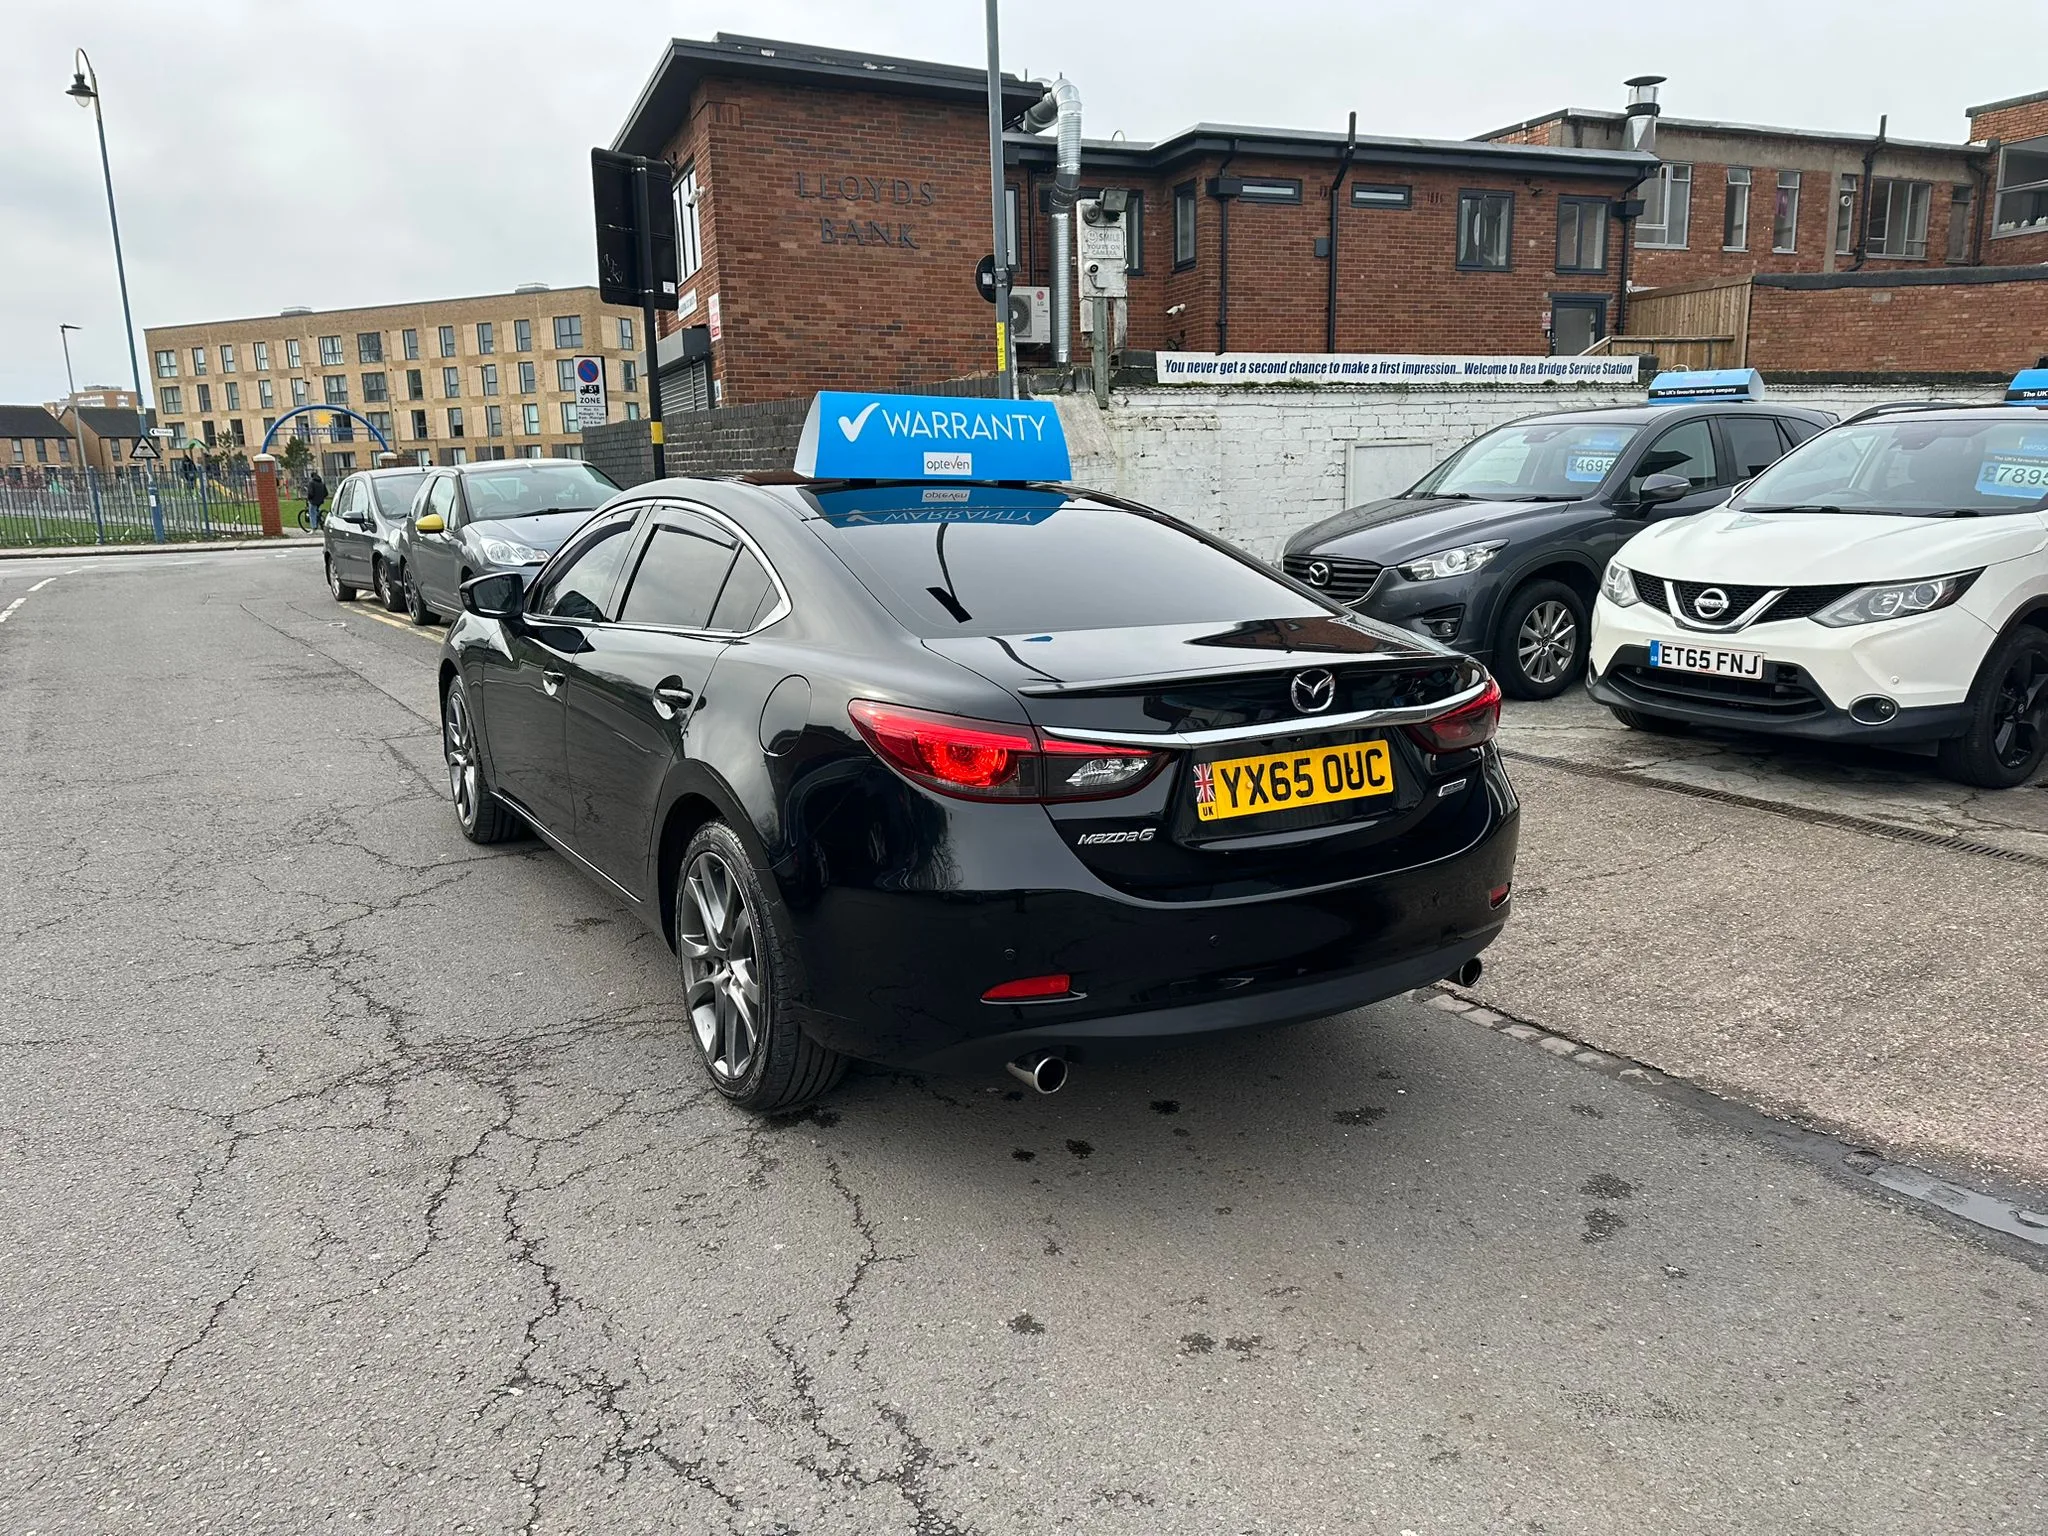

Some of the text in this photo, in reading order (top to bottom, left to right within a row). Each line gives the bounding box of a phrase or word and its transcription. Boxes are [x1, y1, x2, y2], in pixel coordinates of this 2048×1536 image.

[797, 171, 934, 207] LLOYDS
[820, 217, 920, 249] BANK
[1165, 359, 1184, 373] You
[1187, 361, 1218, 374] never
[1219, 361, 1238, 375] get
[1239, 363, 1246, 373] a
[1248, 361, 1287, 374] second
[1289, 360, 1327, 374] chance
[1329, 361, 1340, 374] to
[1341, 361, 1369, 374] make
[1371, 363, 1377, 374] a
[1379, 362, 1400, 374] first
[1464, 362, 1508, 375] Welcome
[1509, 362, 1518, 375] to
[1520, 363, 1536, 375] Rea
[1538, 362, 1567, 376] Bridge
[1568, 362, 1601, 375] Service
[1602, 362, 1633, 375] Station
[882, 409, 1046, 441] WARRANTY
[926, 455, 970, 471] opteven
[1661, 645, 1758, 675] ET65 FNJ
[1220, 748, 1386, 808] YX65 OUC
[1202, 807, 1214, 817] UK
